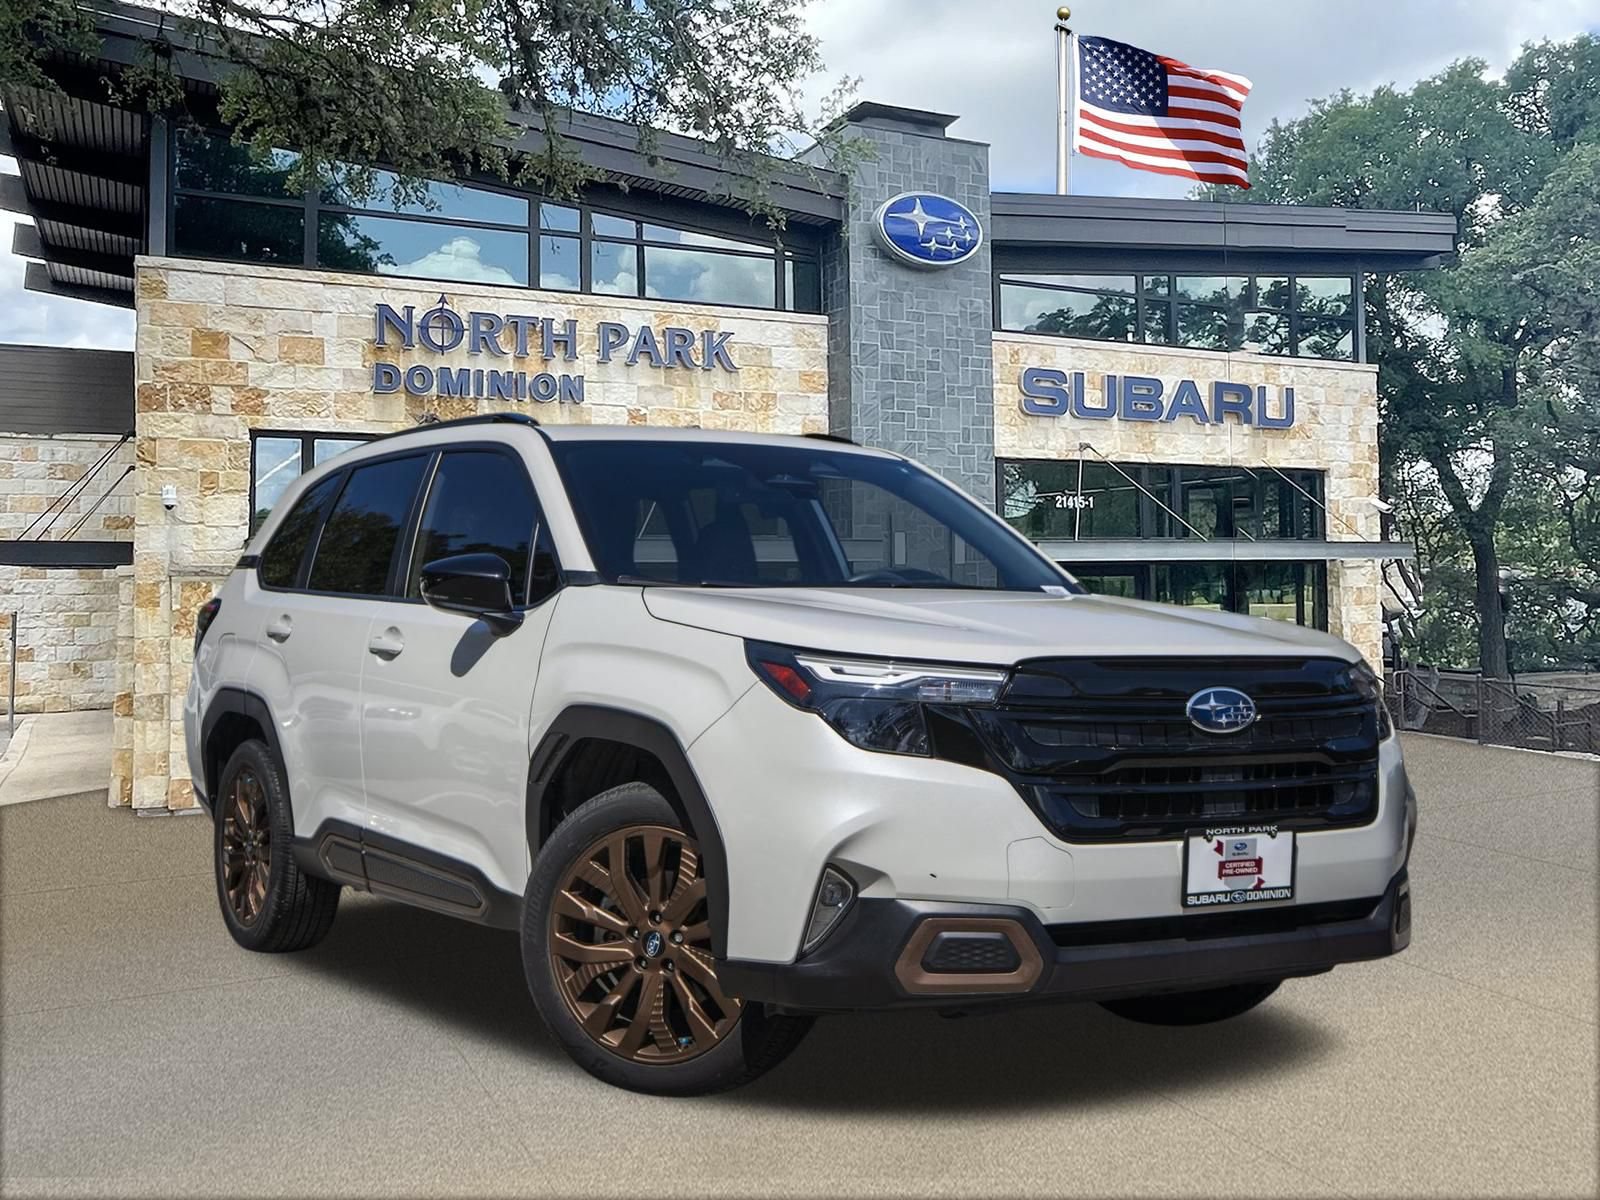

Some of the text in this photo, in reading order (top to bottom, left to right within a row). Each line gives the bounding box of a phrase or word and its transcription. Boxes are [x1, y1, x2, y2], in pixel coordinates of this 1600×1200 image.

[374, 300, 741, 373] NORTH PARK
[372, 361, 586, 405] DOMINION
[1018, 366, 1296, 430] SUBARU
[1205, 825, 1278, 835] NORTH PARK
[1222, 867, 1258, 875] PRE-OWNED
[1225, 861, 1256, 869] CERTIFIED
[1187, 888, 1291, 905] SUBARU DOMINION
